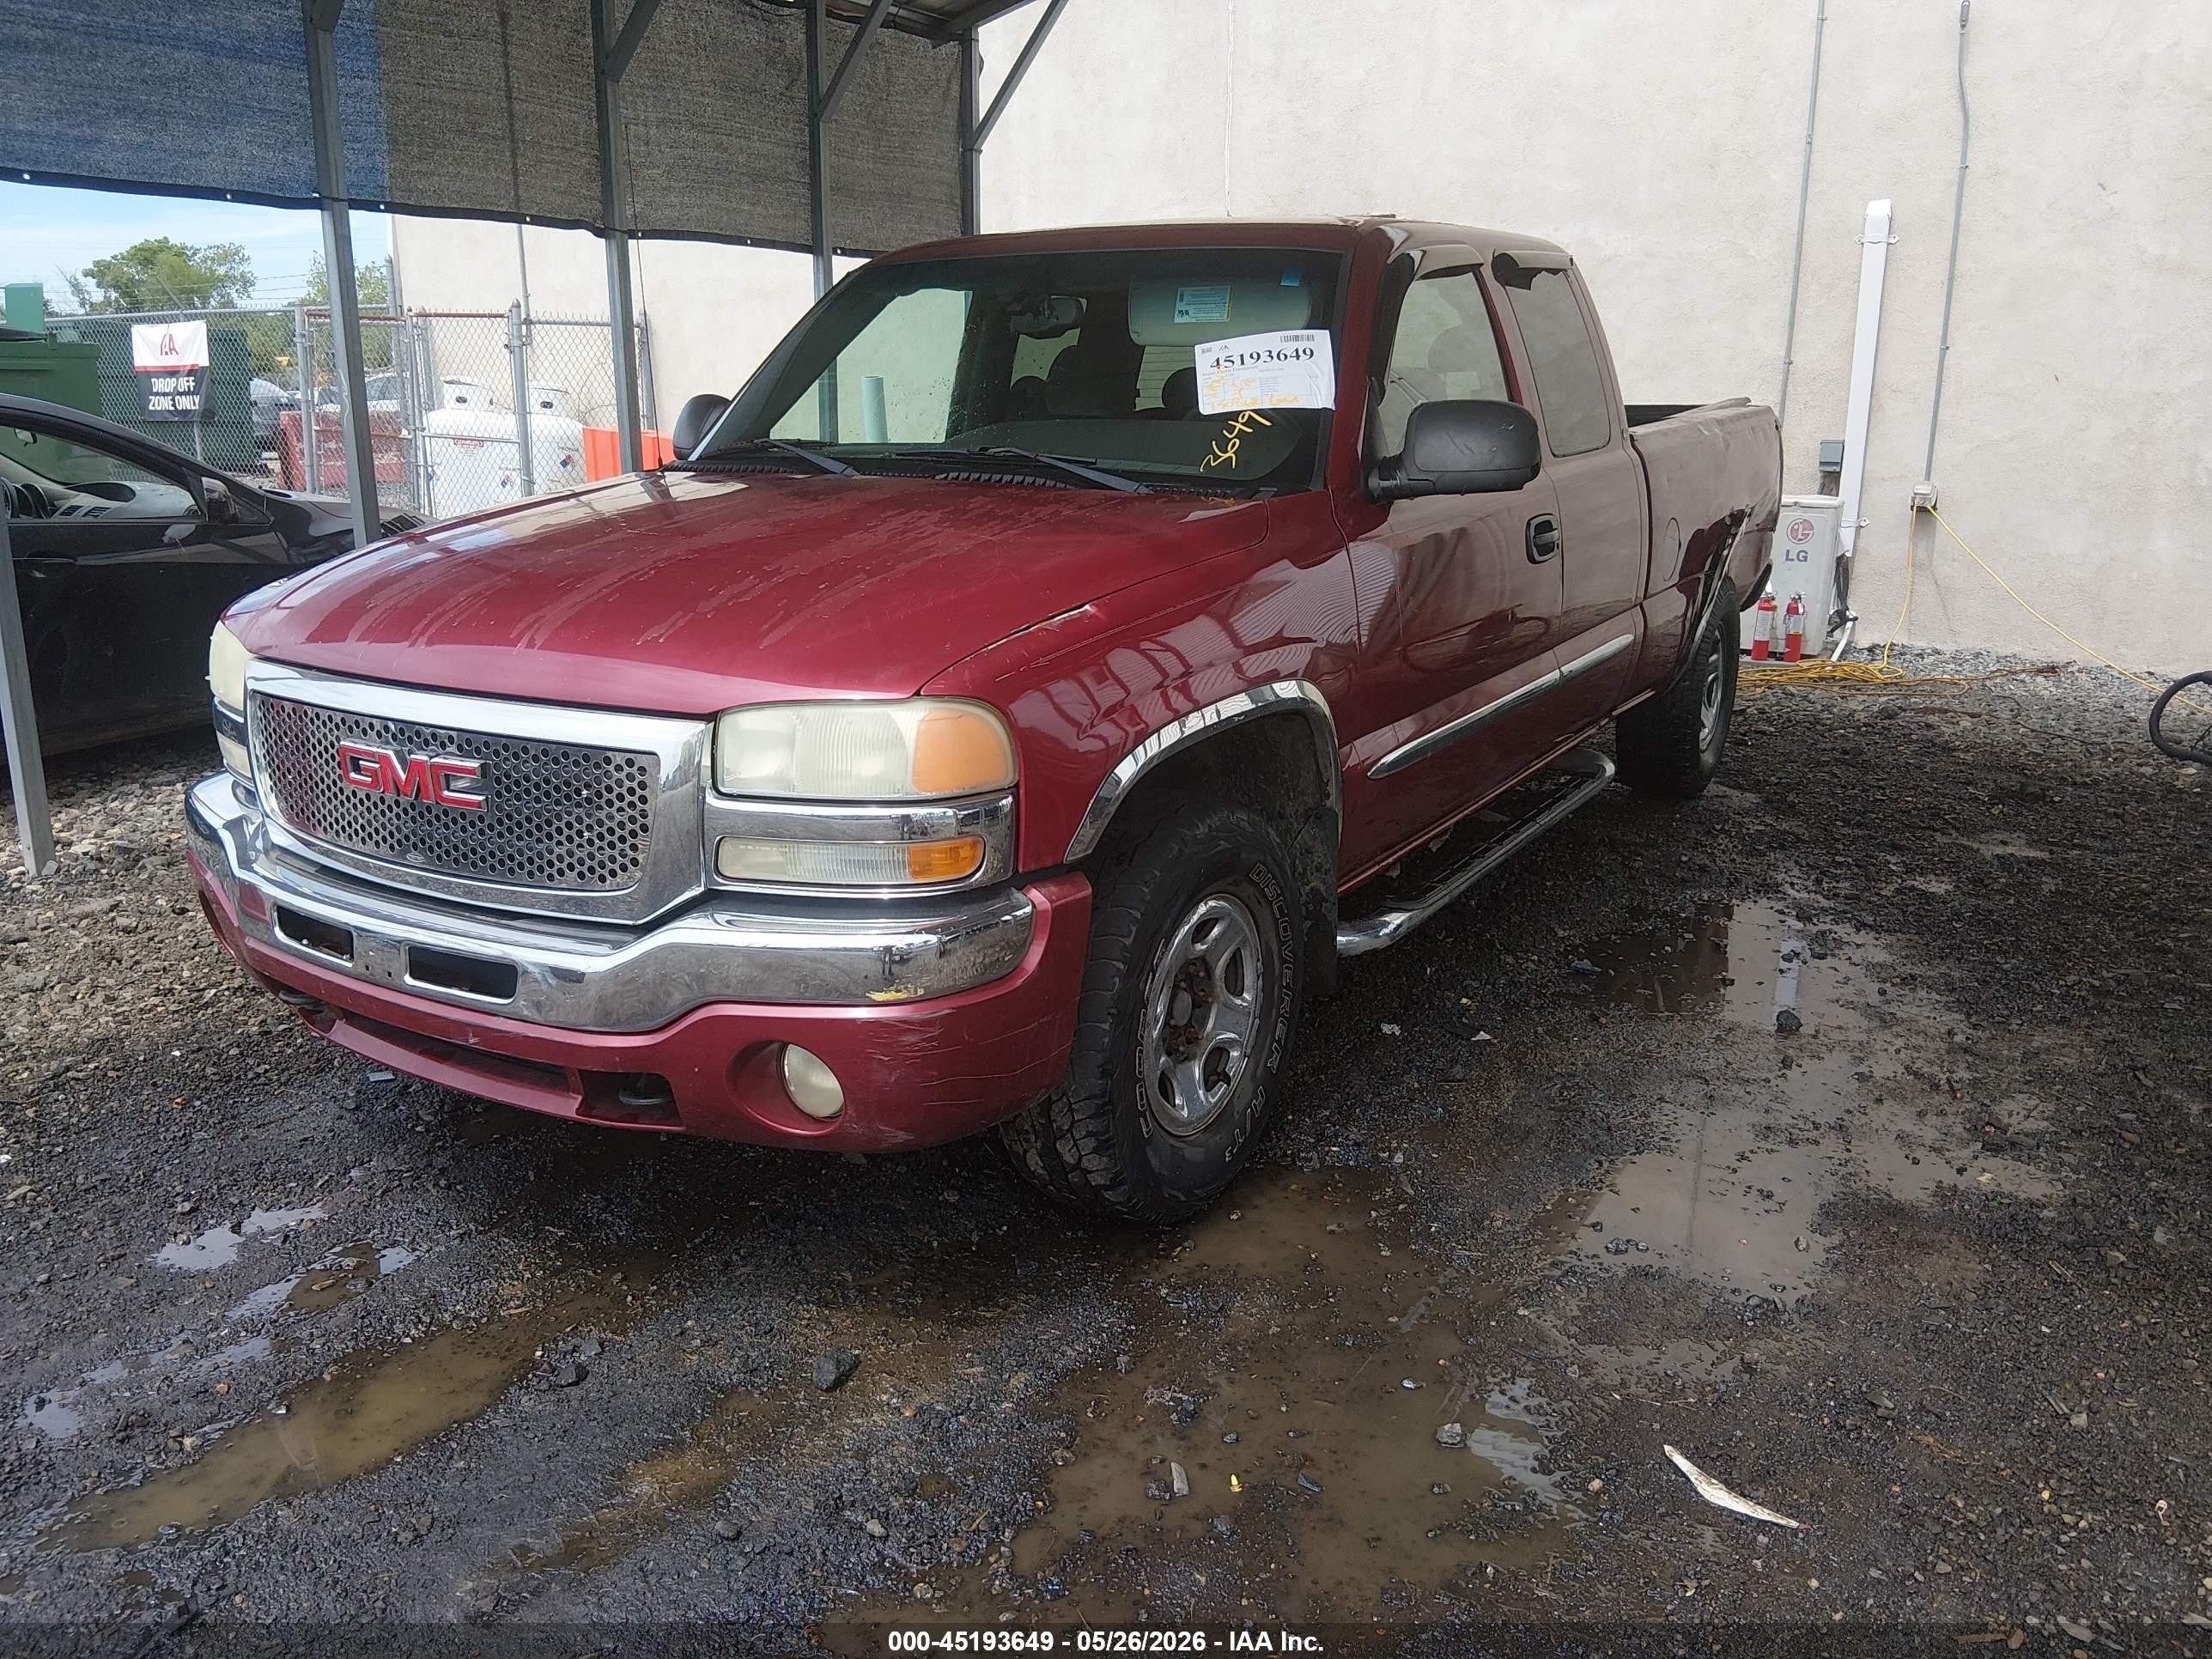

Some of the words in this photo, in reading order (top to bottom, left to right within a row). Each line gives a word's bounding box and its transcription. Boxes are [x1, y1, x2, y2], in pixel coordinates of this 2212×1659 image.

[1210, 347, 1315, 369] 45193649
[151, 378, 177, 392] DROP
[178, 377, 196, 392] OFF
[149, 396, 174, 410] ZONE
[174, 395, 200, 410] ONLY
[1785, 549, 1808, 562] LG
[338, 740, 490, 812] GMC
[1249, 862, 1293, 1074] DISCOVERER
